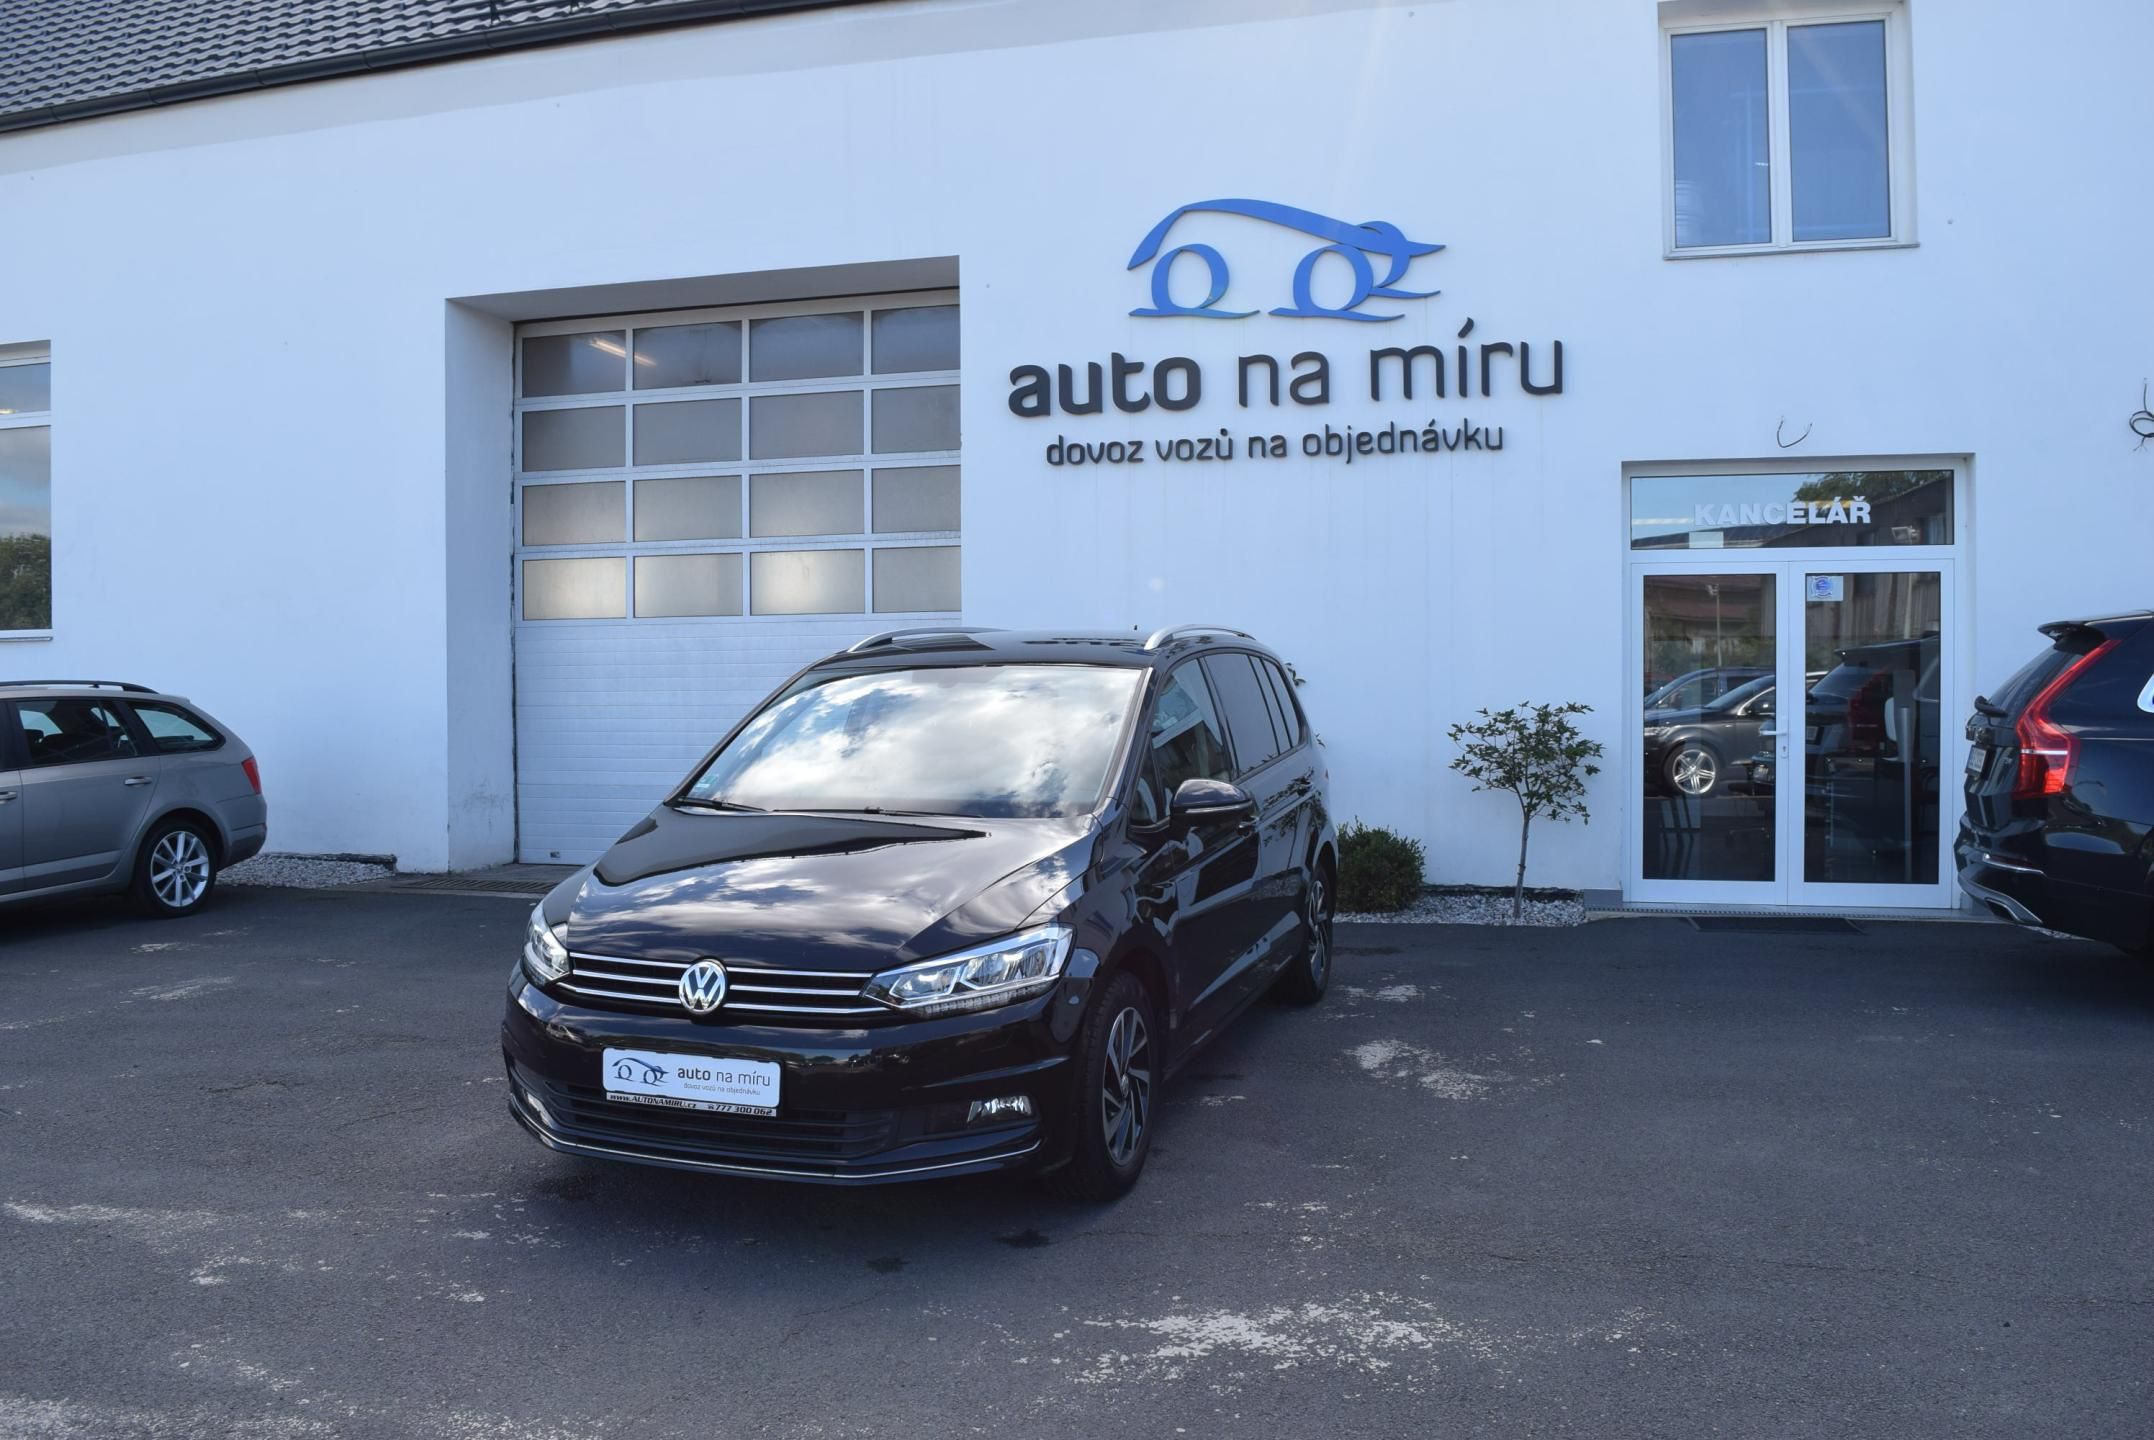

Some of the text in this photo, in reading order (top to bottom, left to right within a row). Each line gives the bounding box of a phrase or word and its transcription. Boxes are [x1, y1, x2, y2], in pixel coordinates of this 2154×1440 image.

[1008, 317, 1563, 417] auto na míru
[1046, 418, 1504, 466] dovoz vozů na objednávku
[1694, 496, 1872, 526] KANCELÁŘ
[677, 1067, 771, 1087] auto na míru
[734, 1105, 753, 1114] 300
